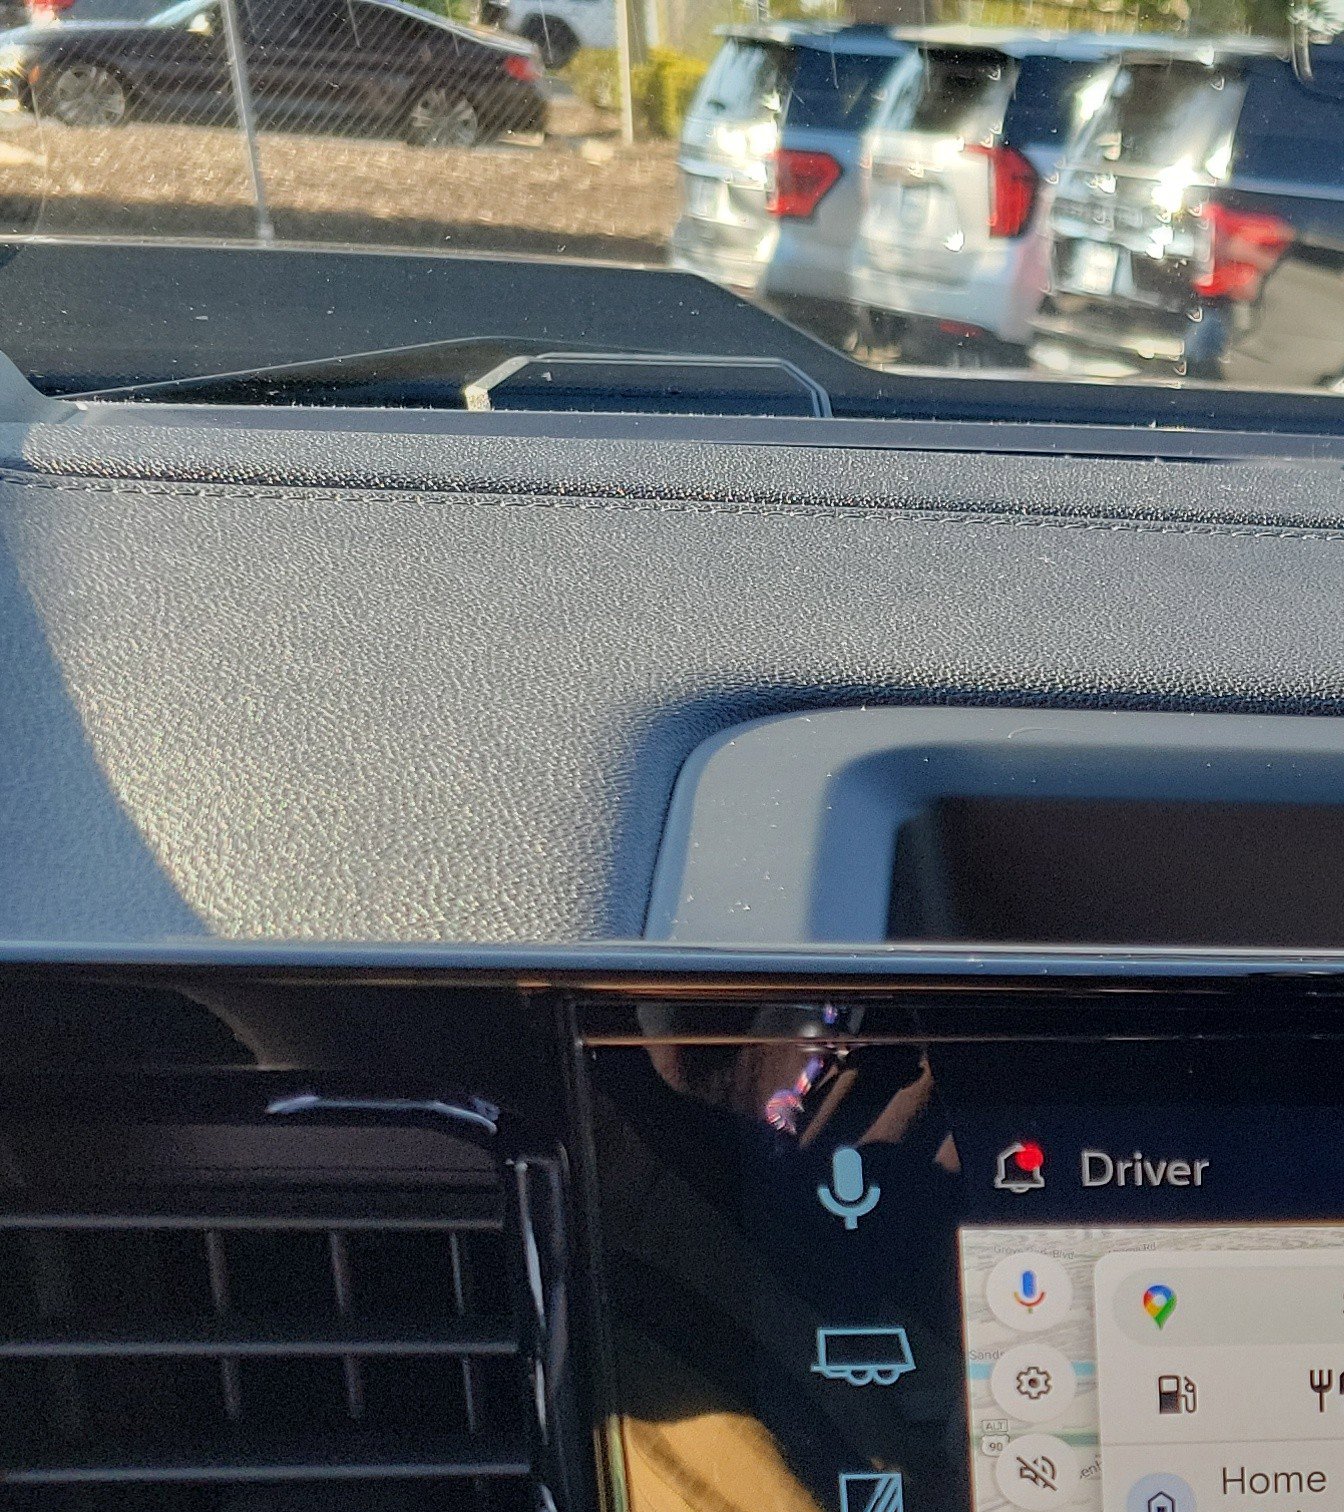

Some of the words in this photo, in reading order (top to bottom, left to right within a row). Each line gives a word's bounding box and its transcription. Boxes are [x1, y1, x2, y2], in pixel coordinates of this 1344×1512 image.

[1082, 1149, 1210, 1187] Driver
[985, 1422, 1004, 1432] ALT
[1221, 1466, 1328, 1496] Home
